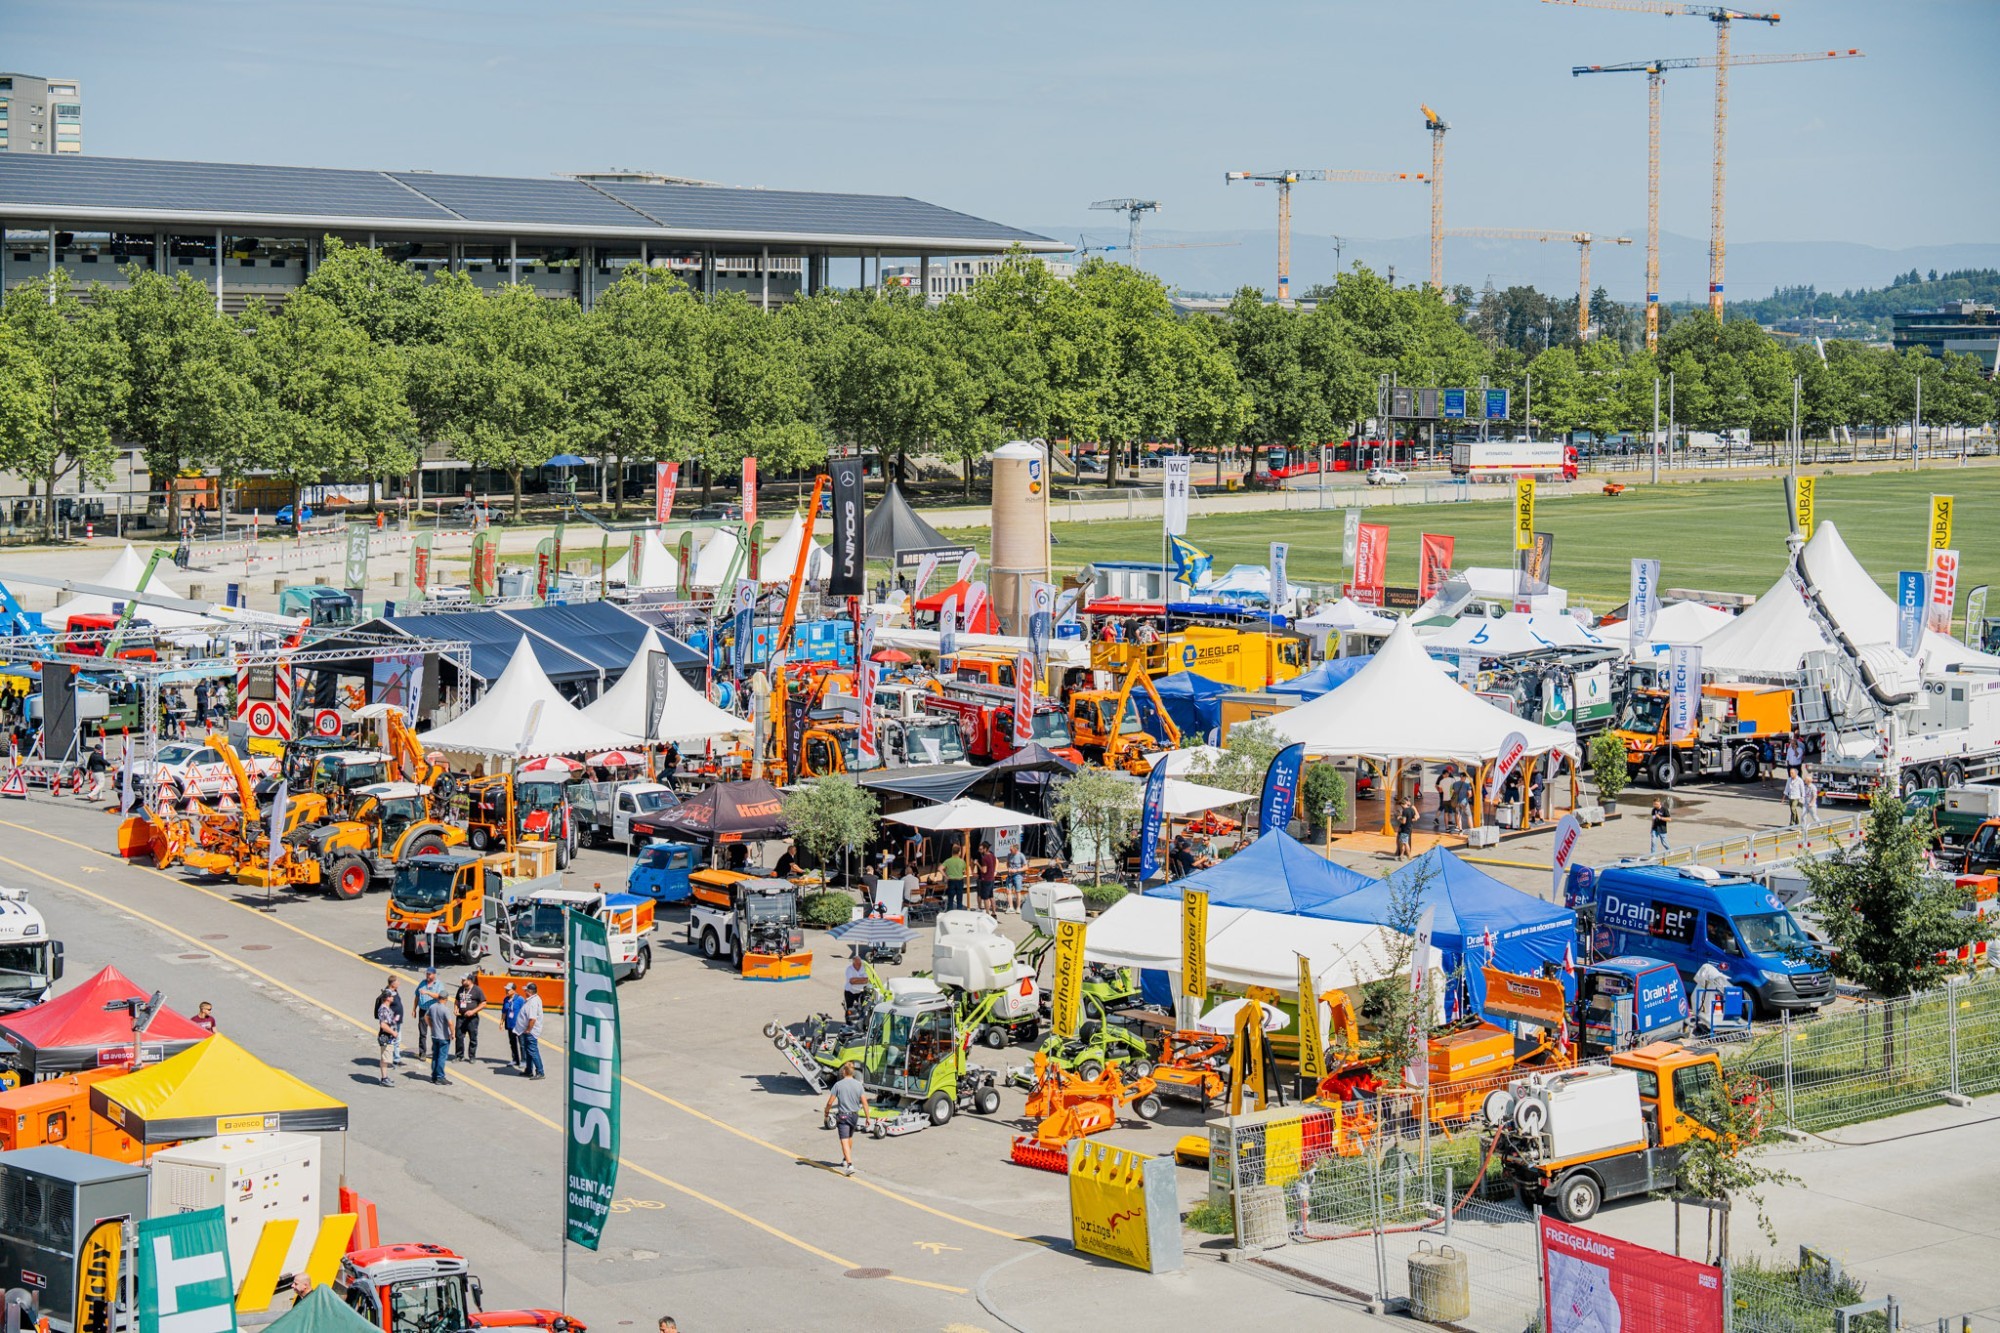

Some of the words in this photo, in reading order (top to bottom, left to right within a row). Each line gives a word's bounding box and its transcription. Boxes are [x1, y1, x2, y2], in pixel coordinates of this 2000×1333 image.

[1170, 463, 1187, 473] WC
[1520, 484, 1532, 531] RUBAG
[1799, 480, 1811, 527] RUBAG
[1934, 501, 1948, 550] RUBAG
[843, 500, 856, 578] UNIMOG
[1909, 576, 1915, 589] AG
[1933, 555, 1956, 606] HUG
[16, 612, 32, 631] Genie
[1967, 591, 1985, 651] TESIA
[1198, 644, 1240, 658] ZIEGLER
[1680, 649, 1687, 663] AG
[655, 657, 666, 725] MERBAG
[1015, 657, 1034, 740] Hako
[255, 713, 270, 726] 80
[322, 718, 335, 730] 60
[792, 708, 803, 770] ERBAG
[1498, 742, 1523, 776] Hako
[736, 800, 783, 818] Hako
[719, 832, 743, 843] Hako
[998, 838, 1017, 848] HAKO
[1008, 830, 1018, 838] MY
[1556, 829, 1577, 868] Hako
[1189, 893, 1198, 919] AG
[1604, 915, 1650, 930] robotics
[1062, 923, 1074, 952] AG
[1188, 919, 1198, 996] Dezlhofer
[1057, 953, 1072, 1034] Dezlhofer
[572, 922, 616, 1149] SILENT
[110, 1052, 135, 1061] avesco
[232, 1120, 261, 1129] avesco
[264, 1118, 278, 1128] CAT
[569, 1174, 598, 1198] SILENT
[598, 1183, 612, 1199] AG
[1546, 1226, 1616, 1260] FREIGELÄNDE
[418, 1280, 437, 1289] SILENT
[437, 1279, 446, 1287] AG
[1699, 1273, 1718, 1283] SUISSE
[1699, 1280, 1718, 1290] PUBLIC
